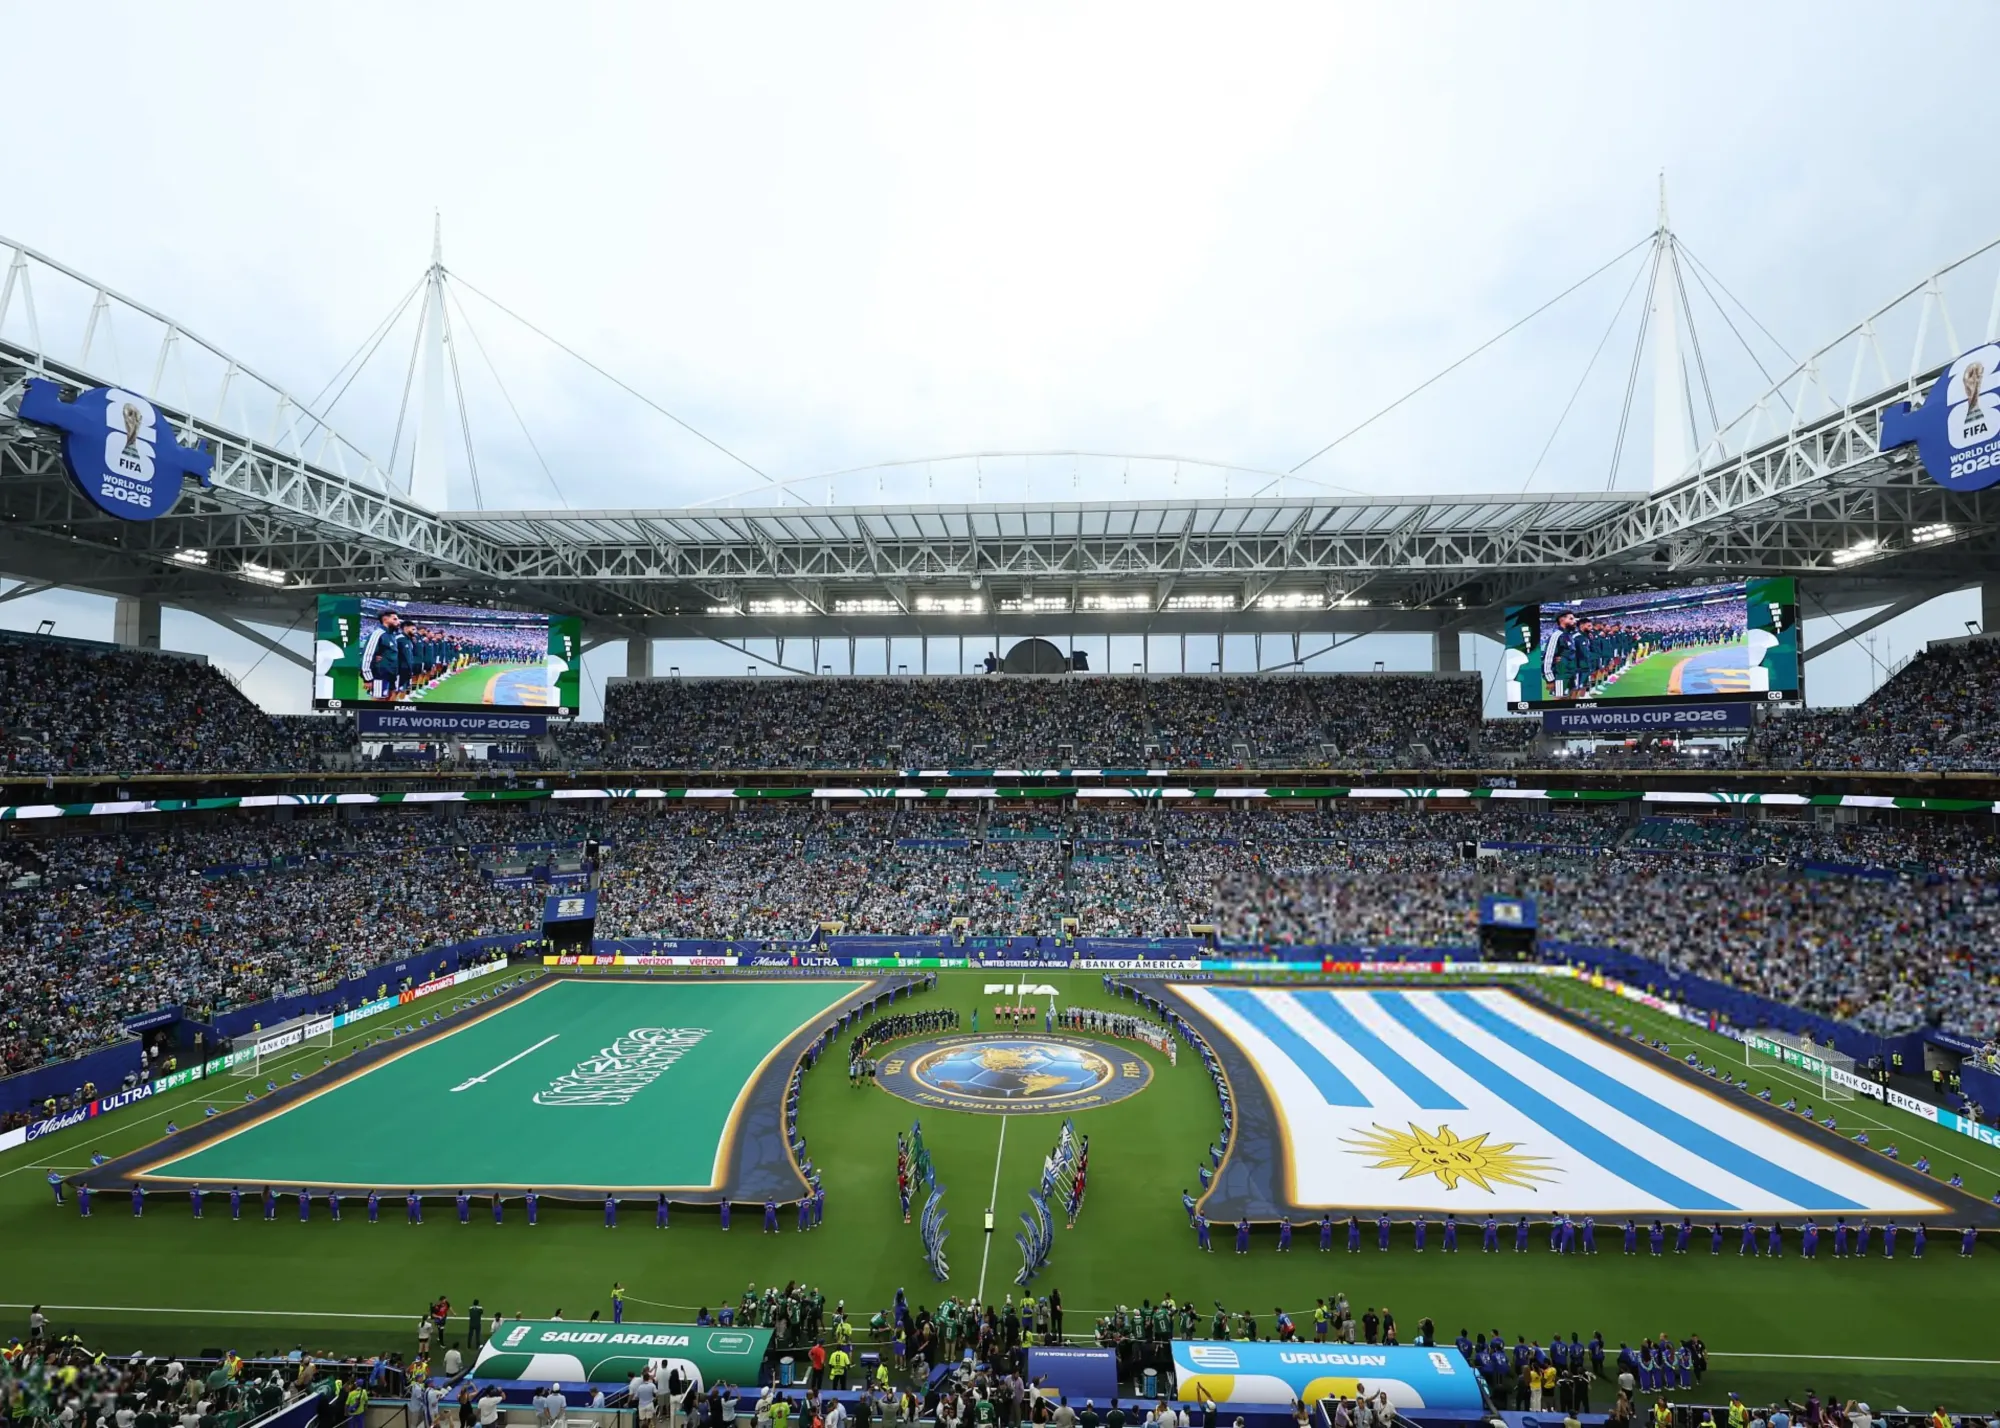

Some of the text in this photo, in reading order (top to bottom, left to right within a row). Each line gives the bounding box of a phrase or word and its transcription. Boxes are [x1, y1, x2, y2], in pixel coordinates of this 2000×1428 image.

[1963, 422, 1988, 439] FIFA
[1950, 446, 1983, 464] WORLD
[119, 458, 142, 473] FIFA
[1950, 452, 2000, 478] 2026
[102, 473, 153, 495] WORLD CUP
[101, 483, 152, 508] 2026
[378, 716, 531, 730] FIFA WORLD CUP 2026
[1561, 710, 1728, 725] FIFA WORLD CUP 2026
[637, 957, 673, 966] verizon
[689, 957, 726, 966] verizon
[750, 957, 839, 967] Michelob ULTRA
[1086, 961, 1185, 969] BANK OF AMERICA
[414, 978, 453, 998] McDonald's
[983, 984, 1060, 996] FIFA
[344, 1001, 390, 1024] Hisense
[279, 1036, 291, 1049] OF
[290, 1024, 325, 1043] AMERICA
[1833, 1070, 1922, 1113] BANK OF AERICA
[915, 1091, 945, 1105] FIFA
[949, 1100, 1007, 1110] WORLD
[27, 1084, 152, 1141] Michelob ULTRA
[540, 1331, 689, 1346] SAUDI ARABIA
[1280, 1352, 1387, 1366] URUGUAY
[980, 1409, 988, 1420] 15
